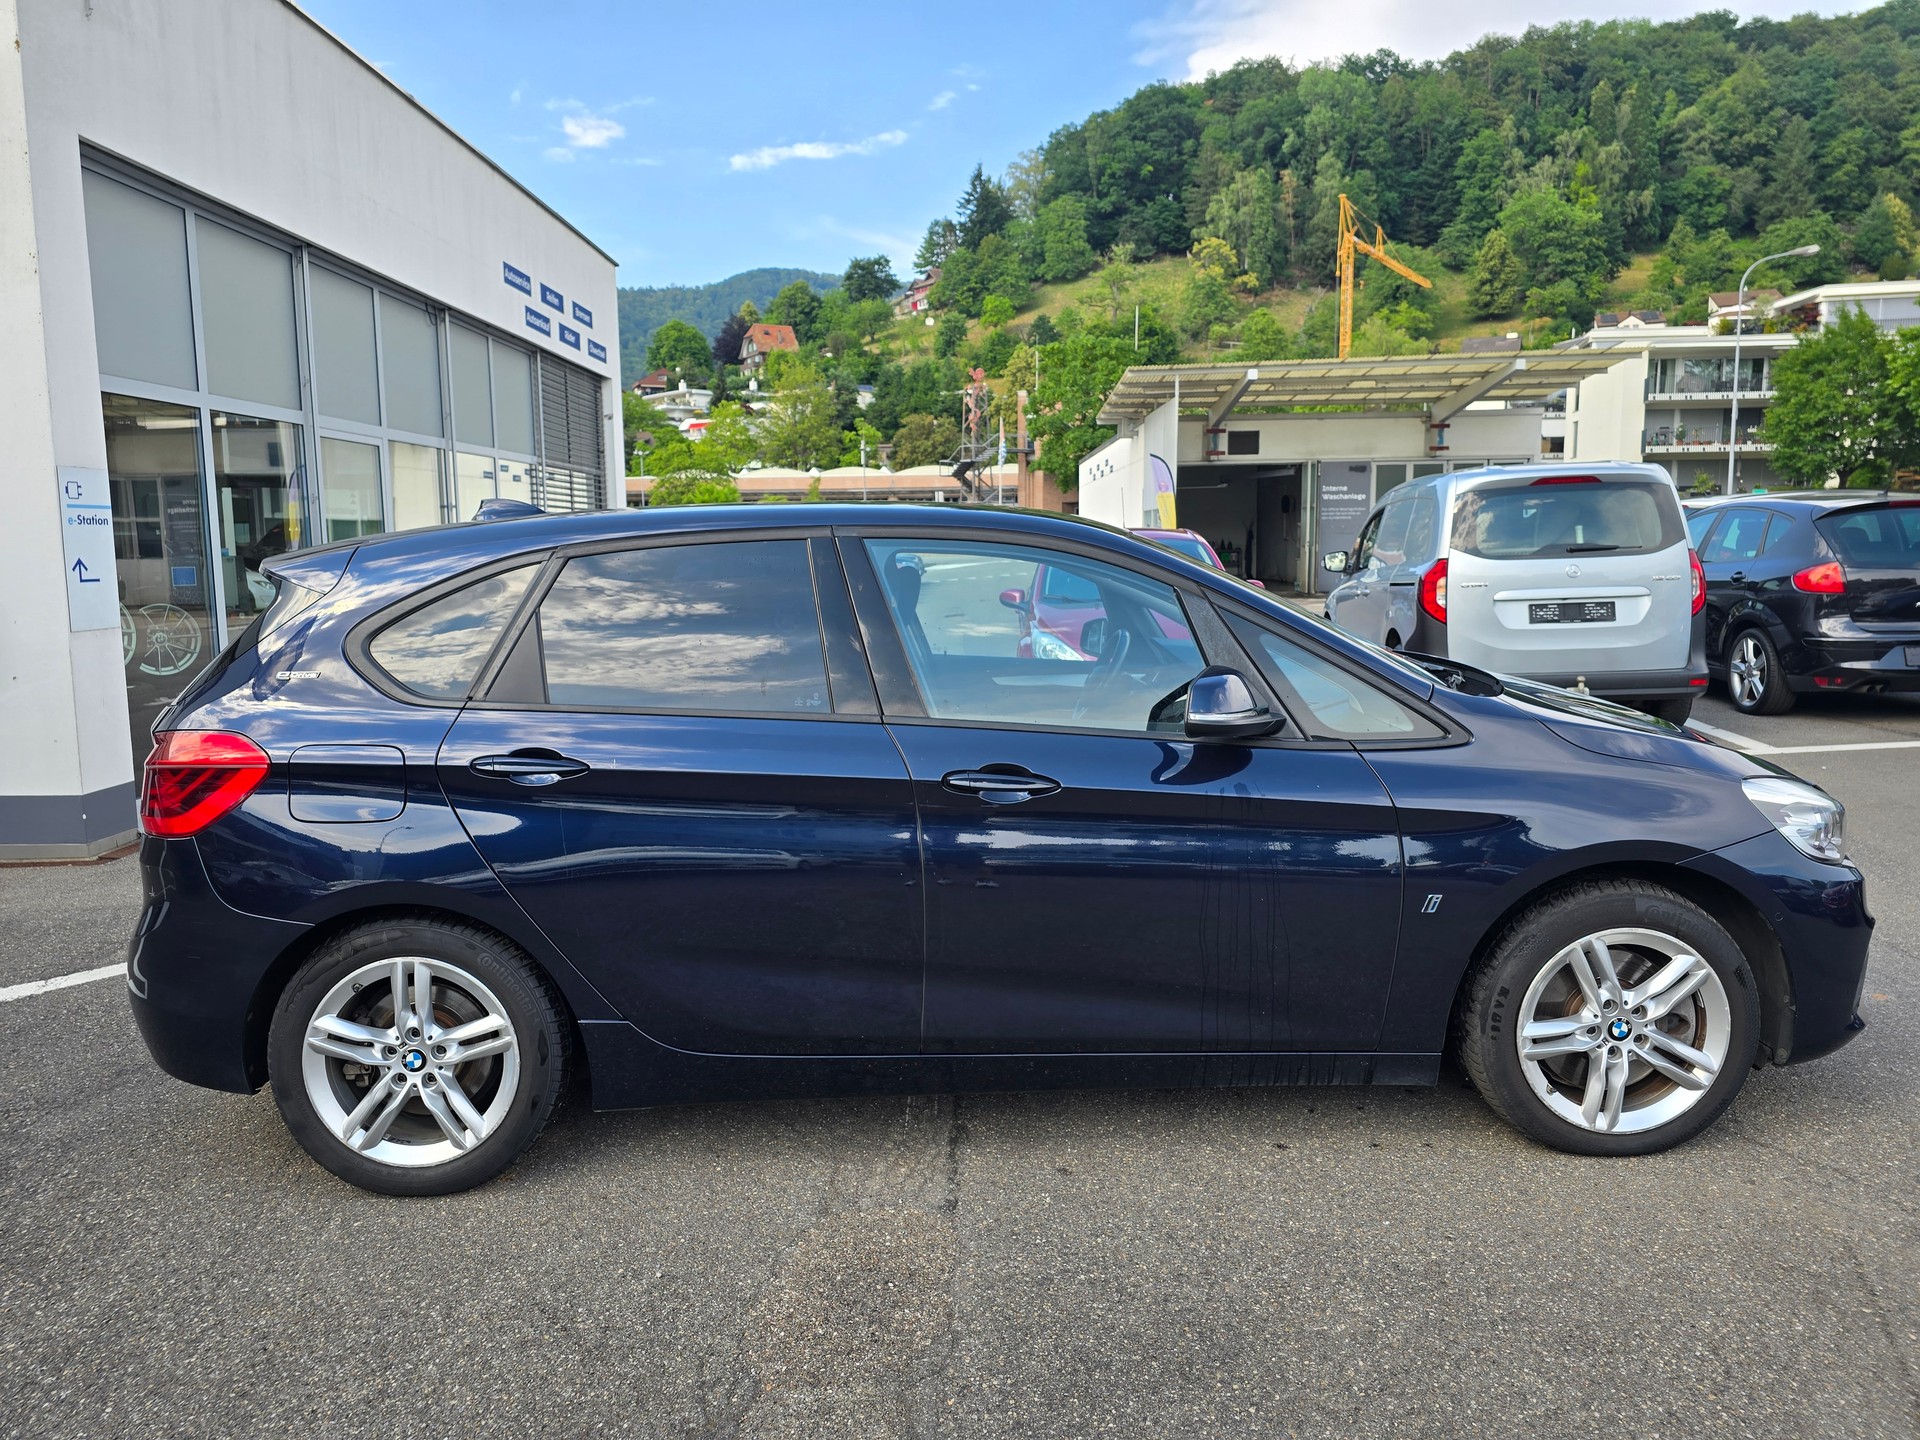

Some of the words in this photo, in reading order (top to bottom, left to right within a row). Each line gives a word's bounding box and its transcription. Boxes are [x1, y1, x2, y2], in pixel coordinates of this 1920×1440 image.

[1322, 493, 1367, 501] Waschanlage
[67, 514, 109, 526] e-Station
[476, 952, 536, 1016] Continental
